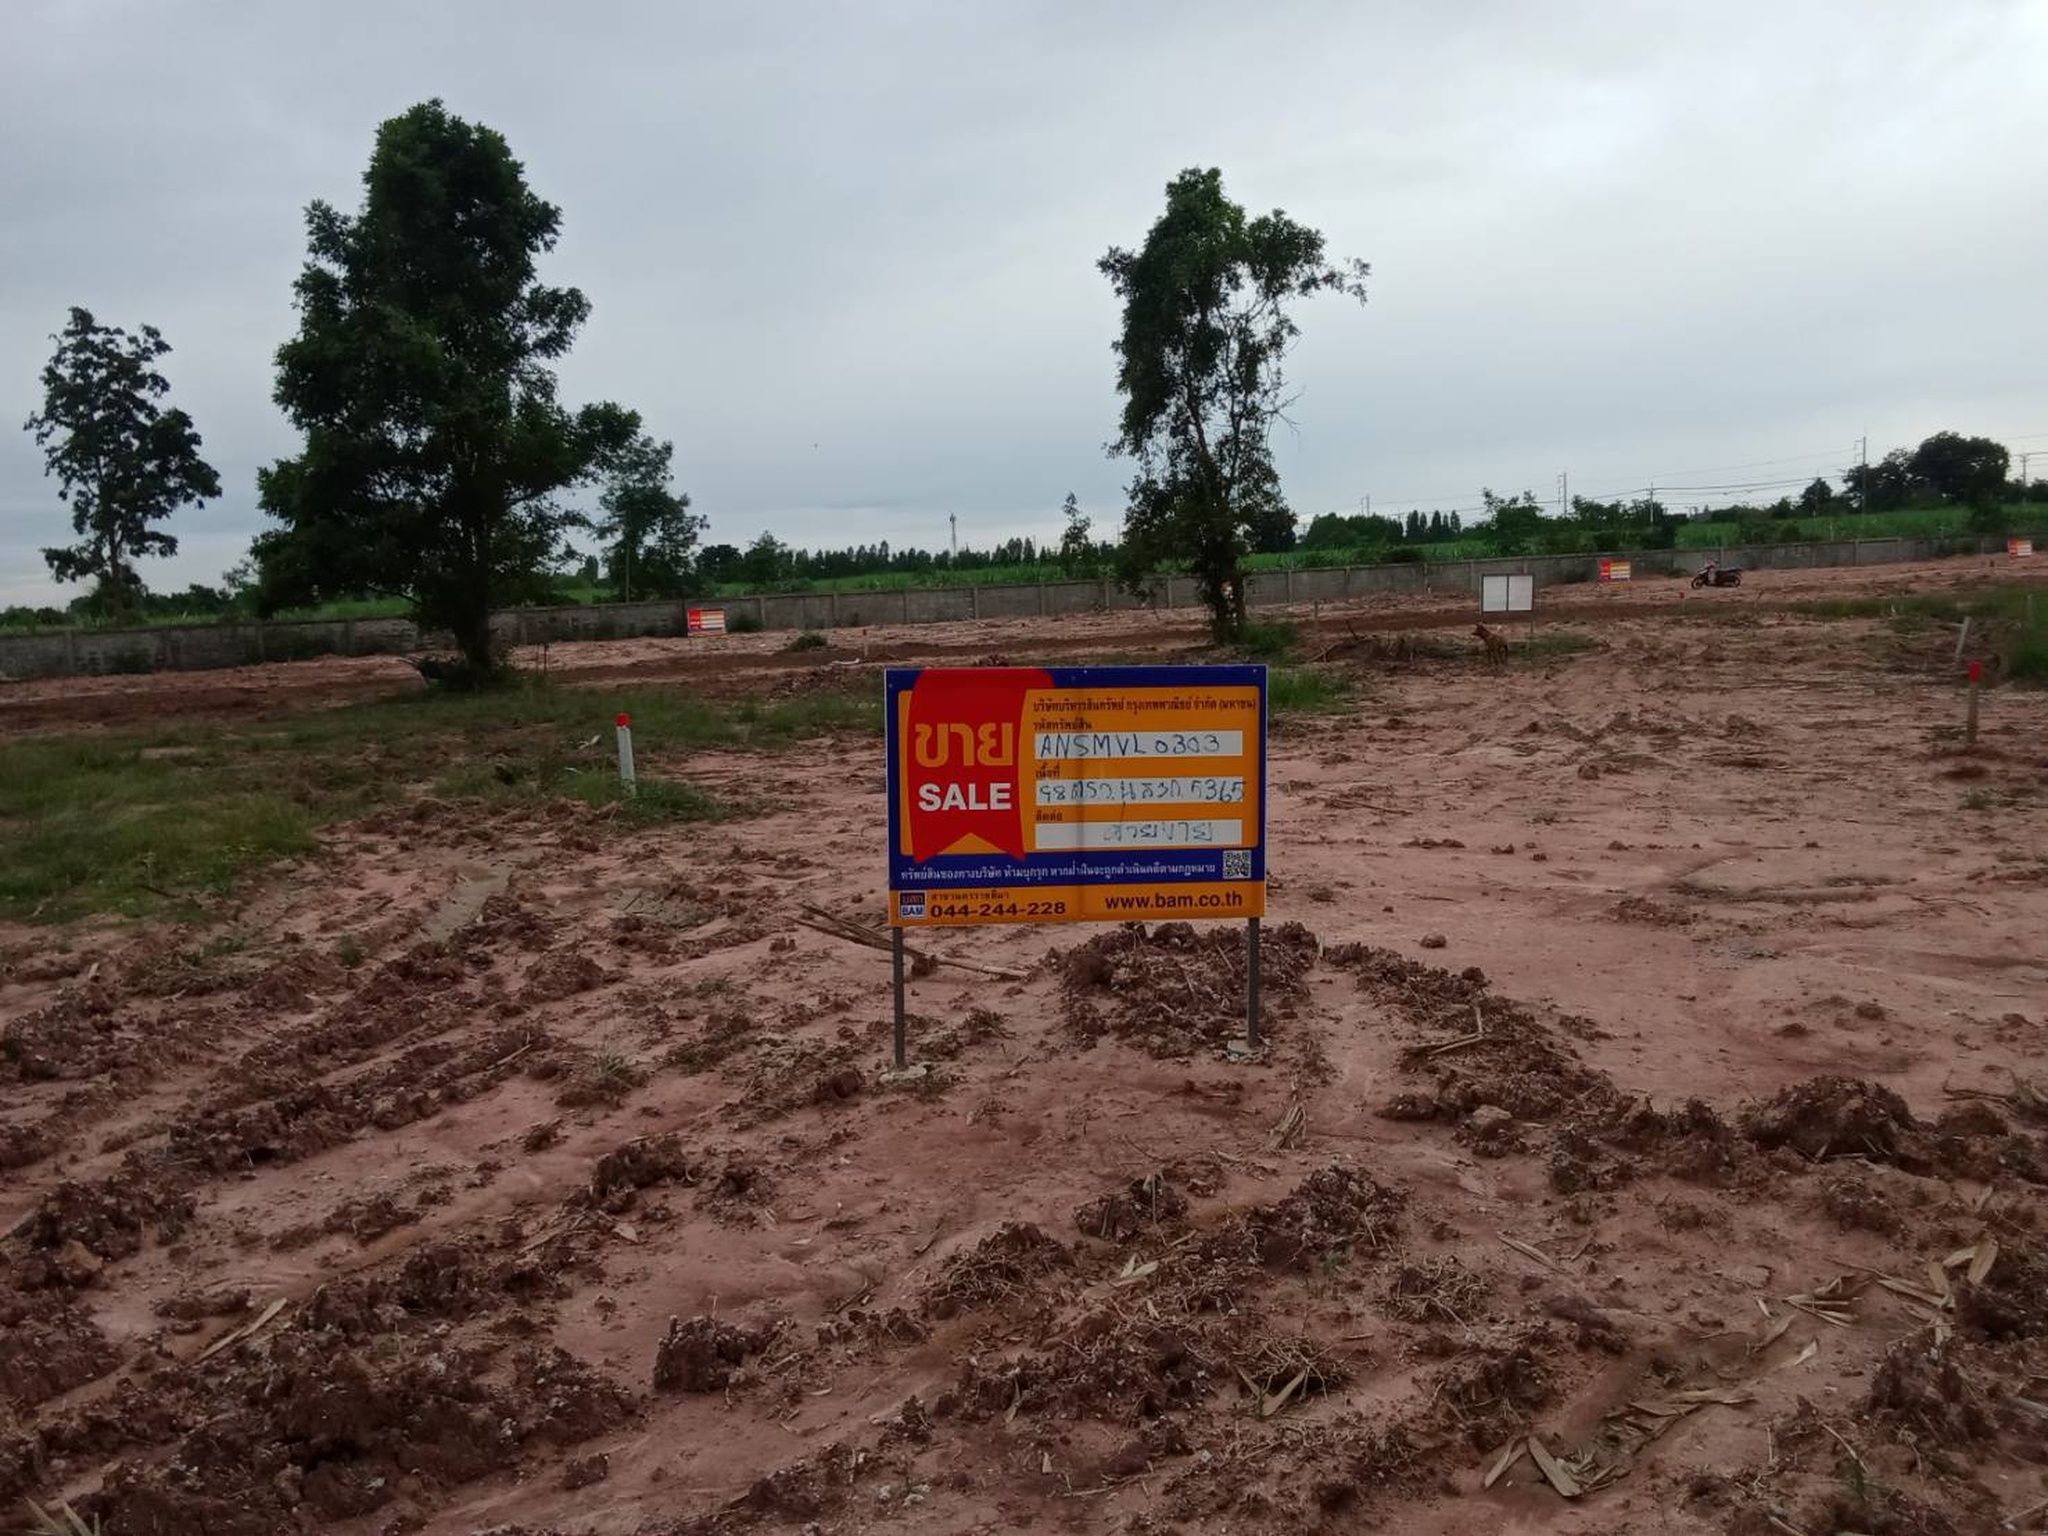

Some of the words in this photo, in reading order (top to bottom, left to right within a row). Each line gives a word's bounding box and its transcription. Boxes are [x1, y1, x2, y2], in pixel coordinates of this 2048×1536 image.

[1194, 696, 1217, 710] จำกัด
[1219, 696, 1256, 711] (มหาชน)
[914, 722, 1014, 768] ขาย
[918, 782, 1012, 812] SALE
[900, 865, 1002, 881] ทรัพย์สินของทางบริษัท
[1004, 863, 1048, 882] ห้ามบุกรุก
[930, 901, 1066, 918] 044-244-228
[1105, 890, 1243, 910] www.bam.co.th
[902, 905, 924, 916] BAM
